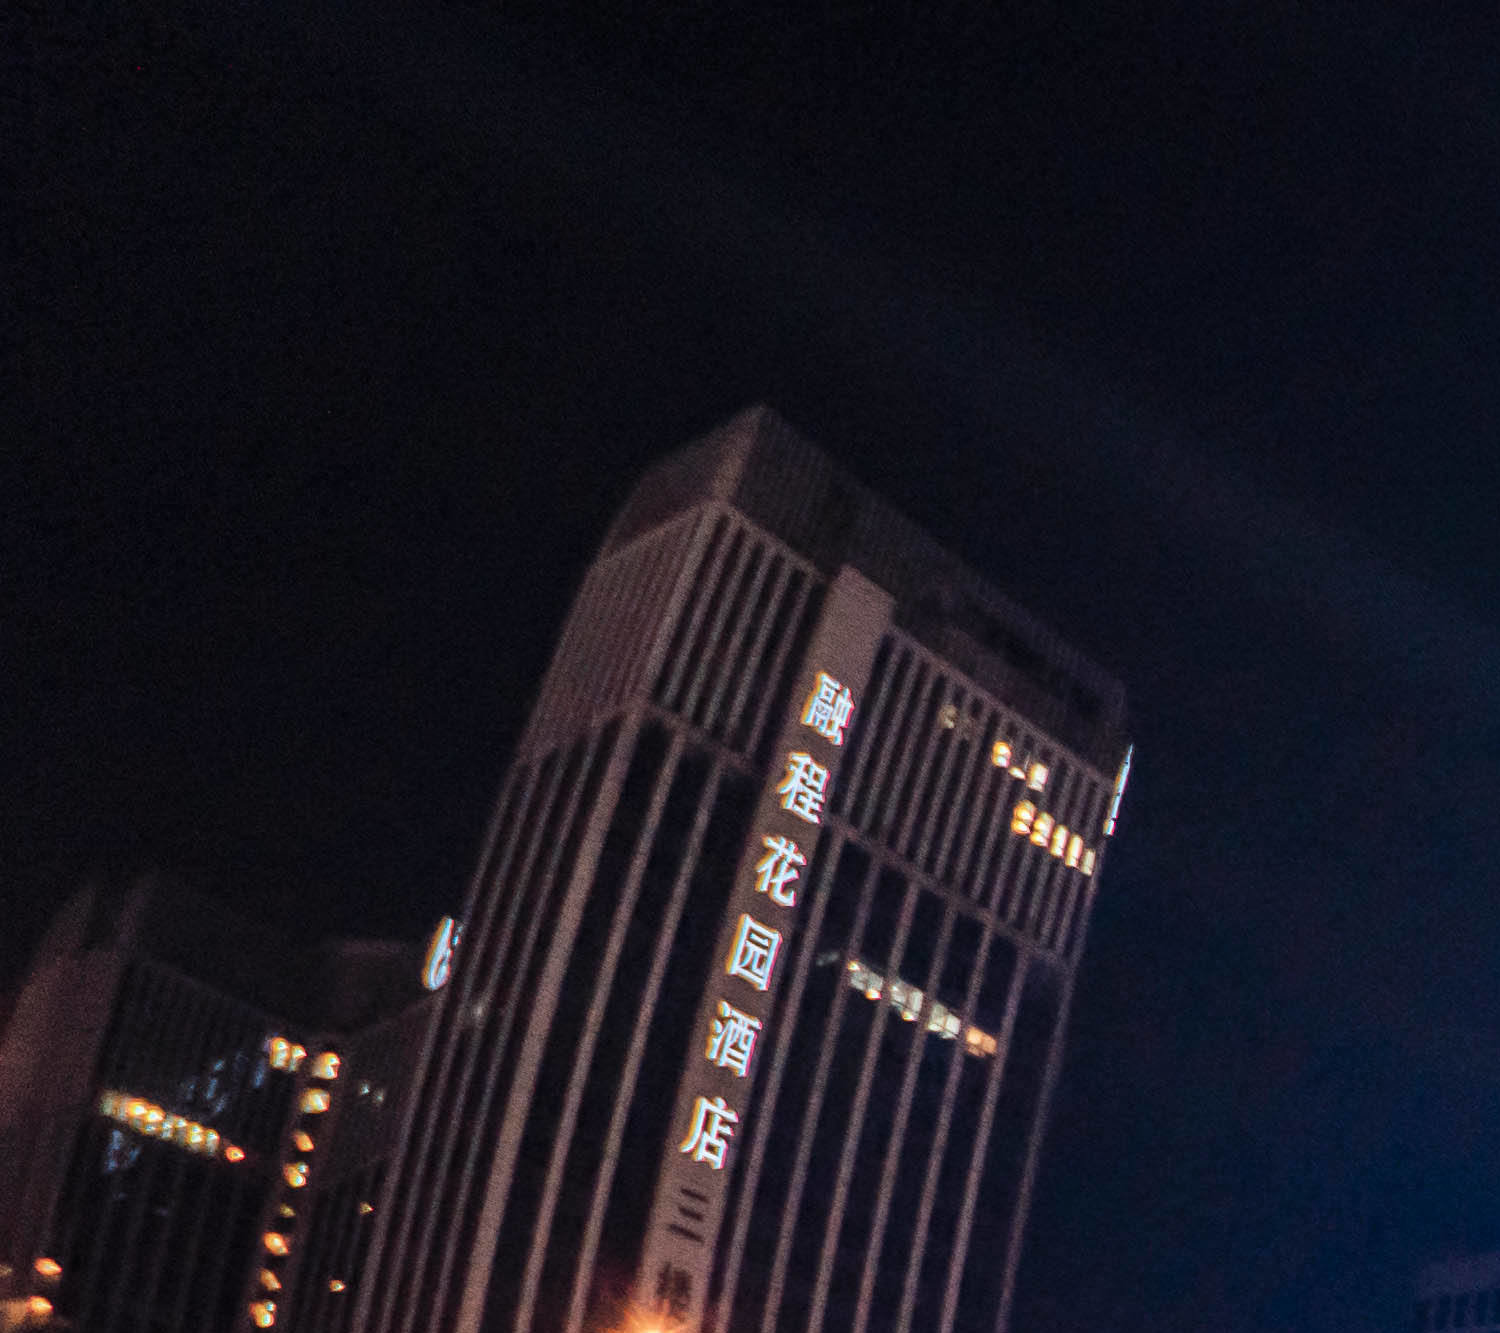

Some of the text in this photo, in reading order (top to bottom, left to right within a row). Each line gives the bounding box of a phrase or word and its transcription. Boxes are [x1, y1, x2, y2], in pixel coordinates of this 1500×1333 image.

[680, 672, 858, 1172] 融程花园酒店
